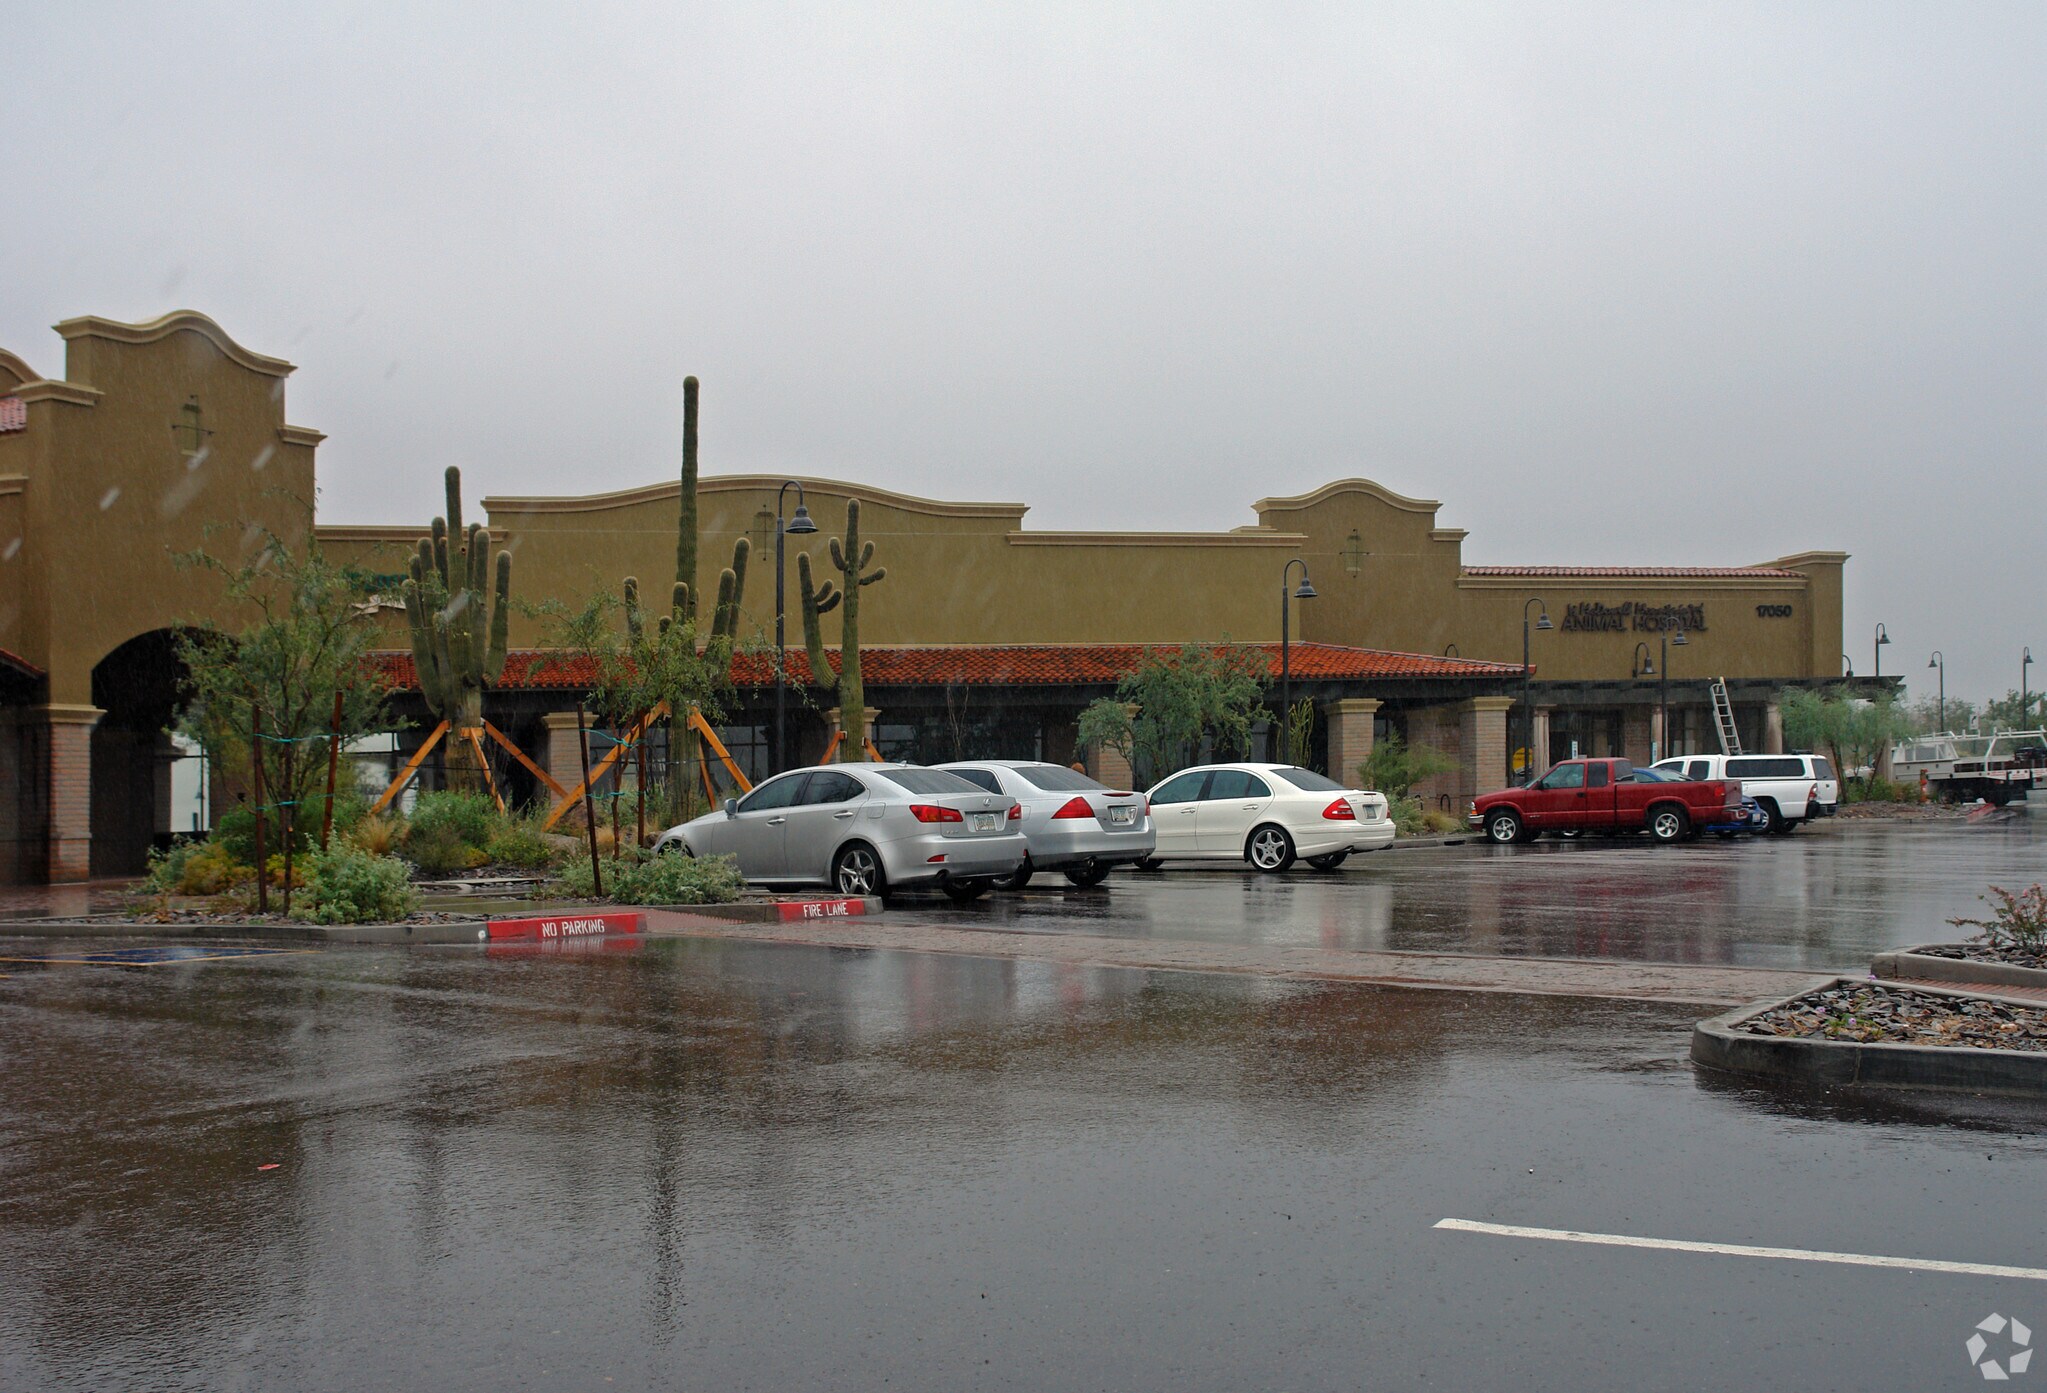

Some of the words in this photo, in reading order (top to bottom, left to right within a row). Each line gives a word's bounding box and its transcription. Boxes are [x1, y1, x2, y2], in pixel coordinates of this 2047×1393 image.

[1755, 604, 1793, 617] 17050
[1560, 614, 1627, 632] ANIMAL
[803, 904, 823, 917] FIRE
[826, 902, 849, 916] LANE
[541, 922, 558, 938] NO
[561, 918, 605, 936] PARKING
